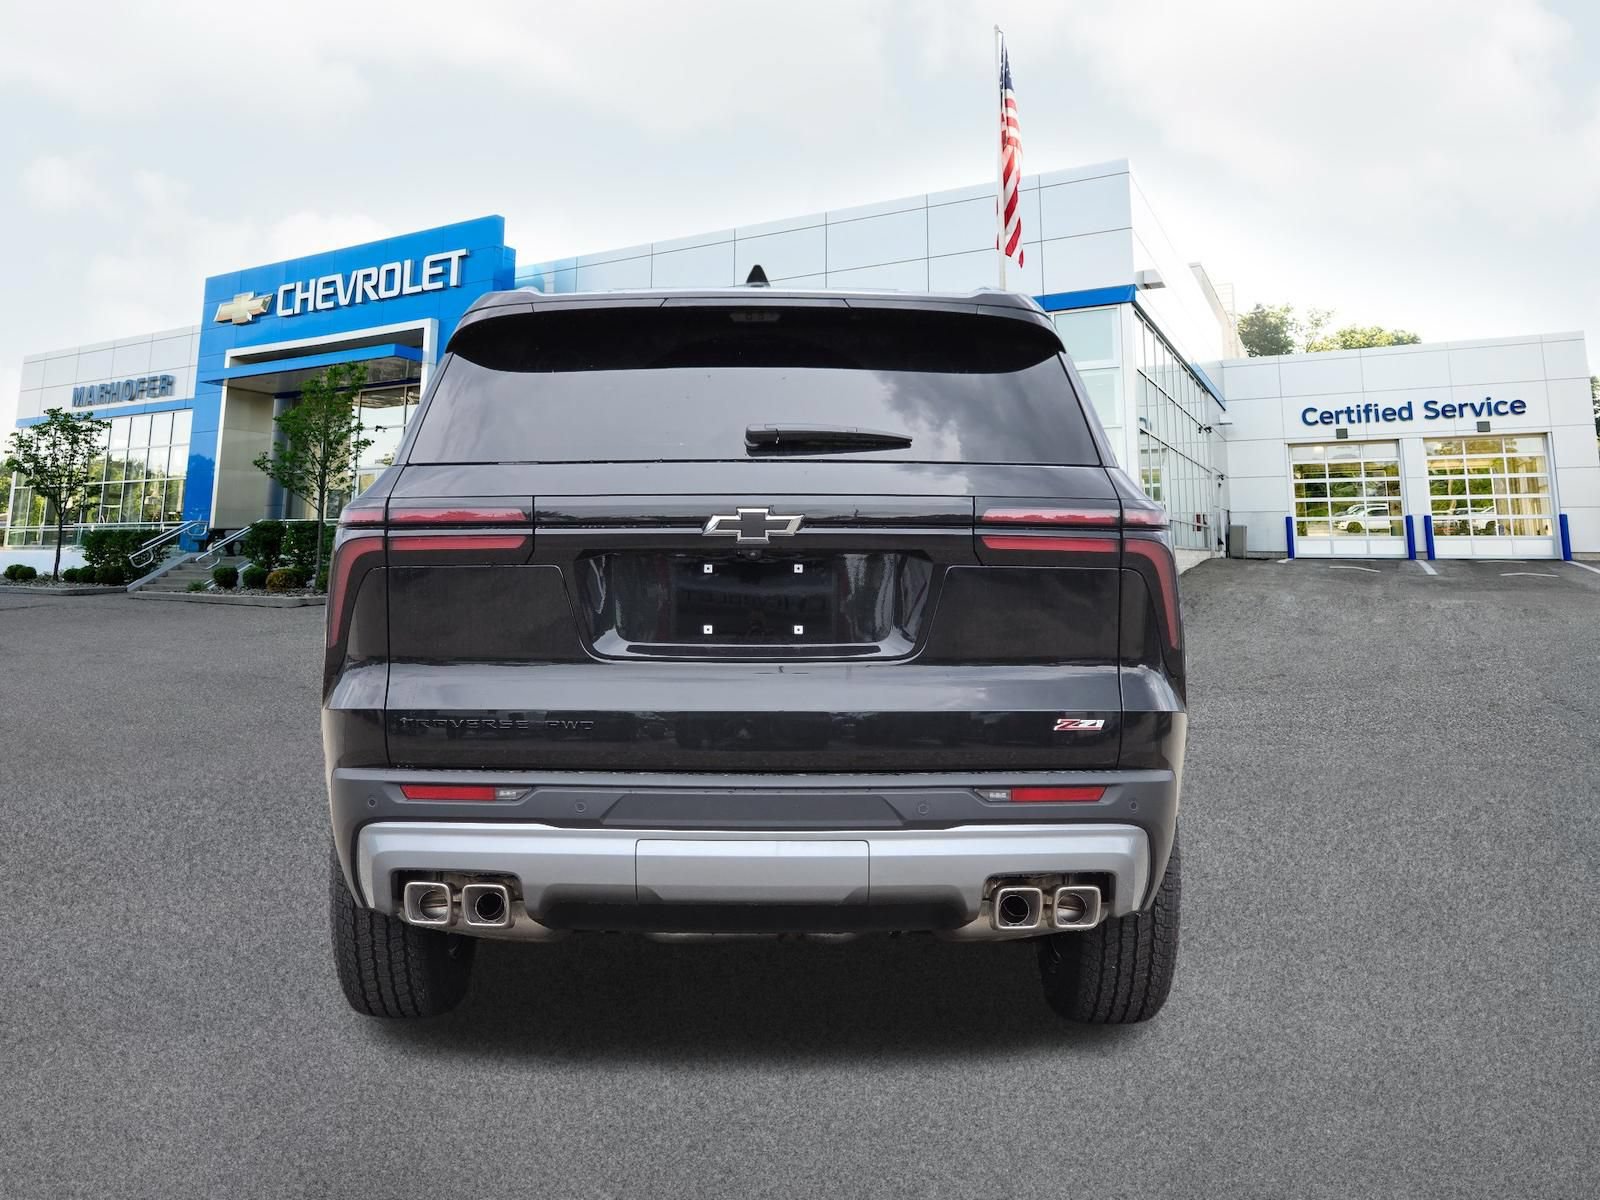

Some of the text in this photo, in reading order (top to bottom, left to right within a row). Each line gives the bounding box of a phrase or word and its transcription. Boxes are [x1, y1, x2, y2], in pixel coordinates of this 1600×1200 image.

[276, 248, 469, 318] CHEVROLET
[72, 374, 175, 407] MARHOFER
[1302, 396, 1527, 426] Certified Service
[399, 717, 529, 730] TRAVERSE
[1053, 718, 1105, 731] Z71
